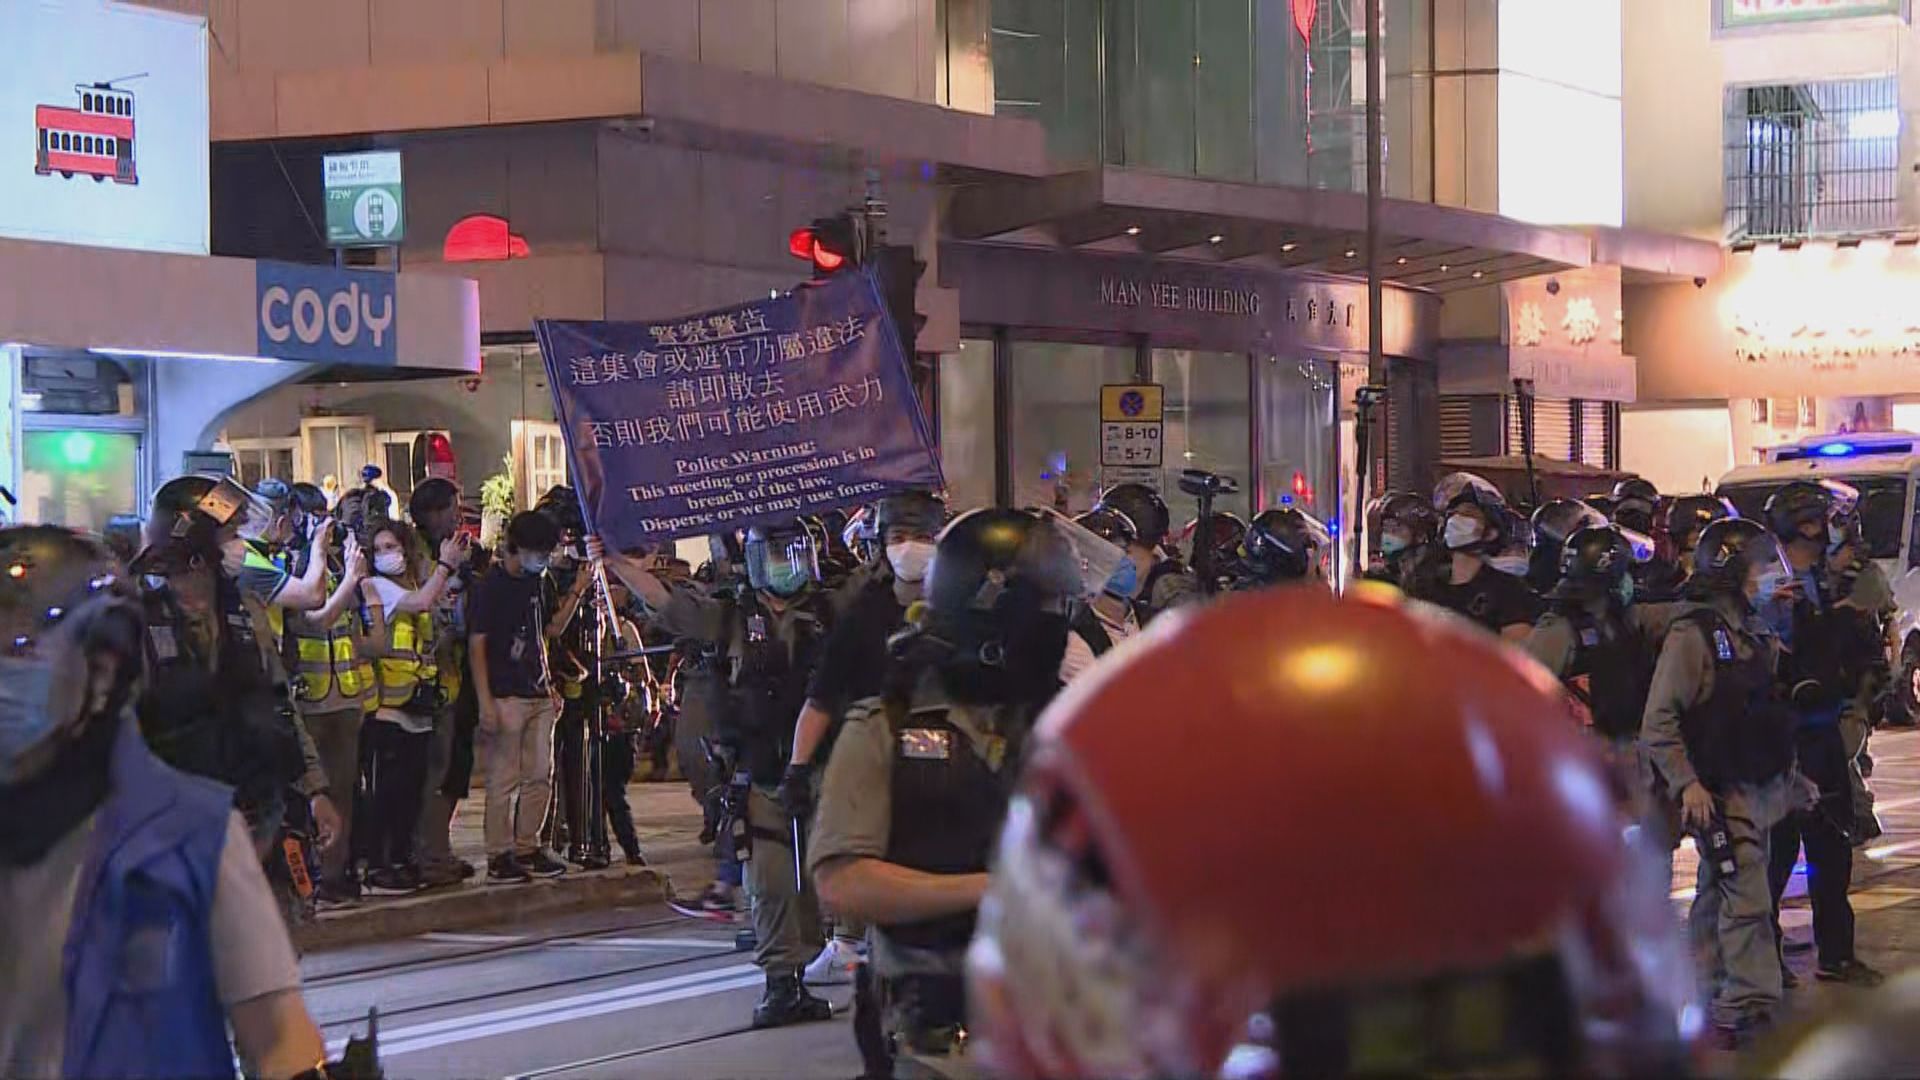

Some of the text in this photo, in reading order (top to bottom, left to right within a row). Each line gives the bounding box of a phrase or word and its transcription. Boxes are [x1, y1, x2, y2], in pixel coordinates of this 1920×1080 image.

[262, 282, 392, 347] cody
[1101, 279, 1260, 315] MAN YEE BUILDING
[650, 308, 769, 345] 警察警告
[570, 316, 865, 385] 這集會或遊行乃屬違法
[666, 370, 785, 409] 請即散去
[585, 376, 882, 448] 否則我們可能使用武力
[1125, 428, 1158, 439] 8-10
[676, 441, 817, 474] Police Warning:
[1125, 448, 1152, 459] 5-7
[627, 446, 875, 501] This meeting or procession is in
[687, 475, 832, 510] breach of the law.
[640, 481, 884, 532] Disperse or we may use force.
